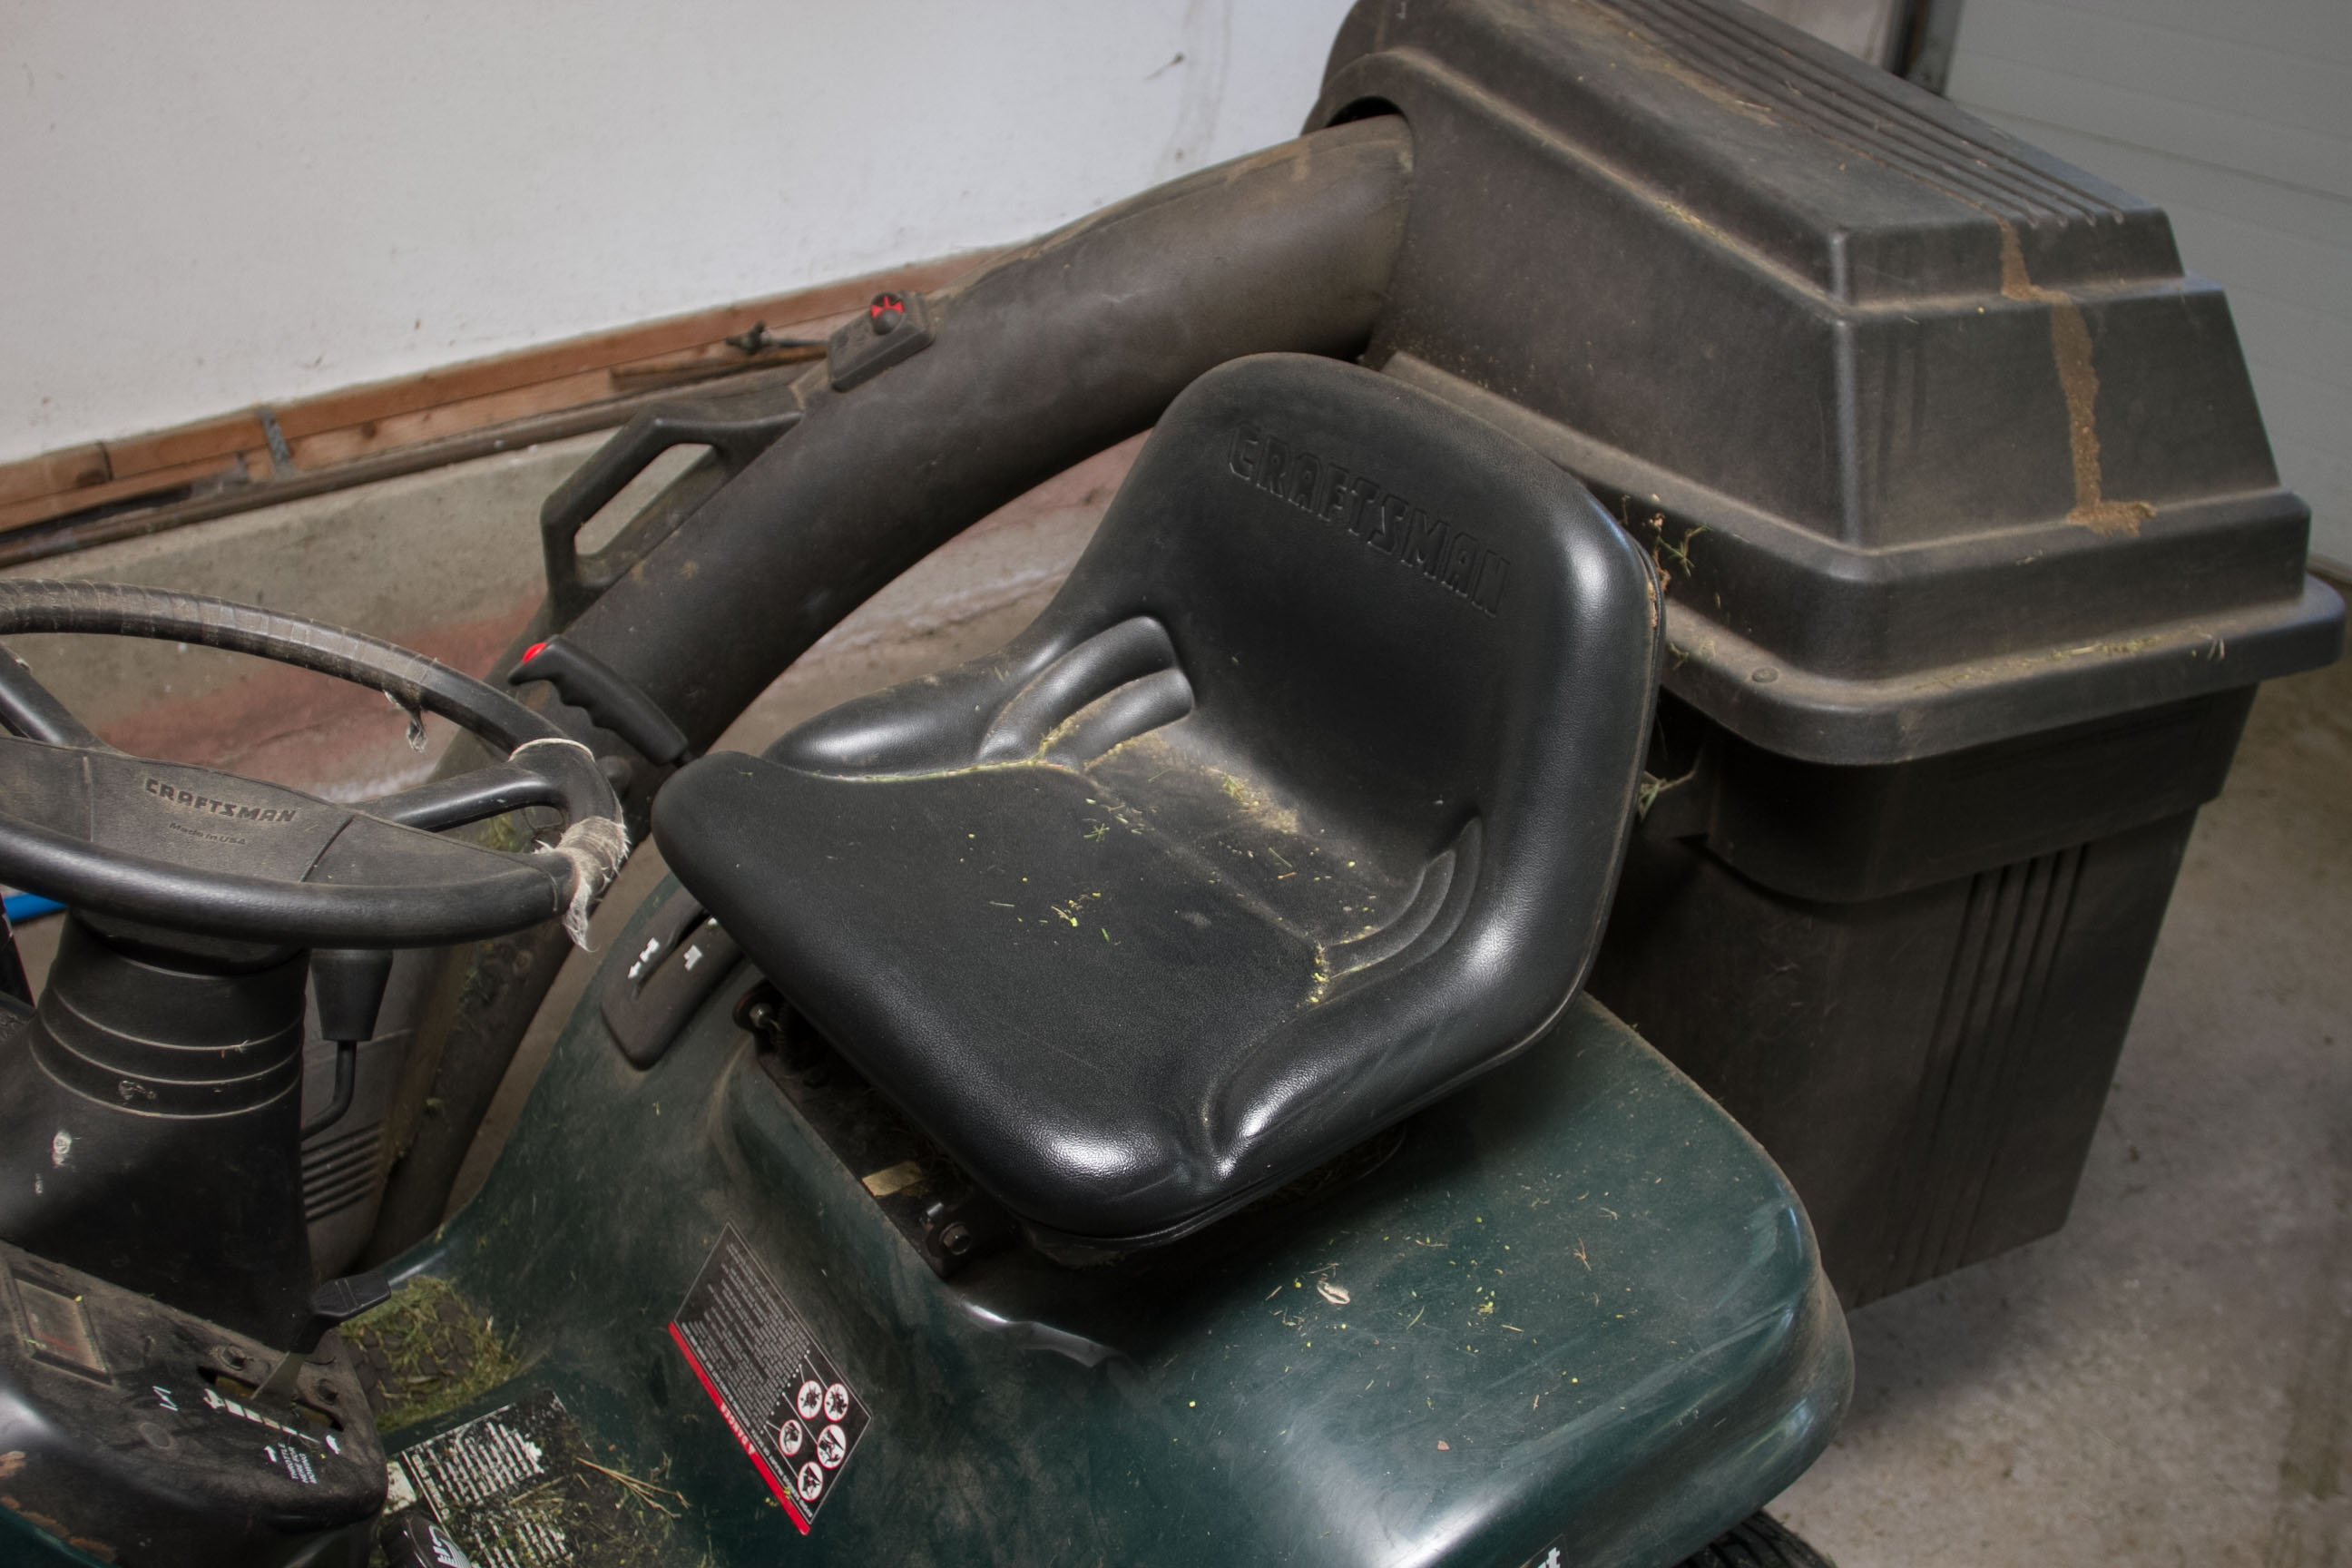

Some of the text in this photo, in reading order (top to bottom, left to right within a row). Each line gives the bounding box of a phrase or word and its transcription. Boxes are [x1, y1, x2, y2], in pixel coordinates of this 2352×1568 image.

[1229, 425, 1510, 618] CRAFTSMAN
[145, 778, 297, 822] CRAFTSMAN
[169, 822, 204, 838] Made
[219, 836, 246, 845] USA
[719, 1400, 749, 1446] DANGER
